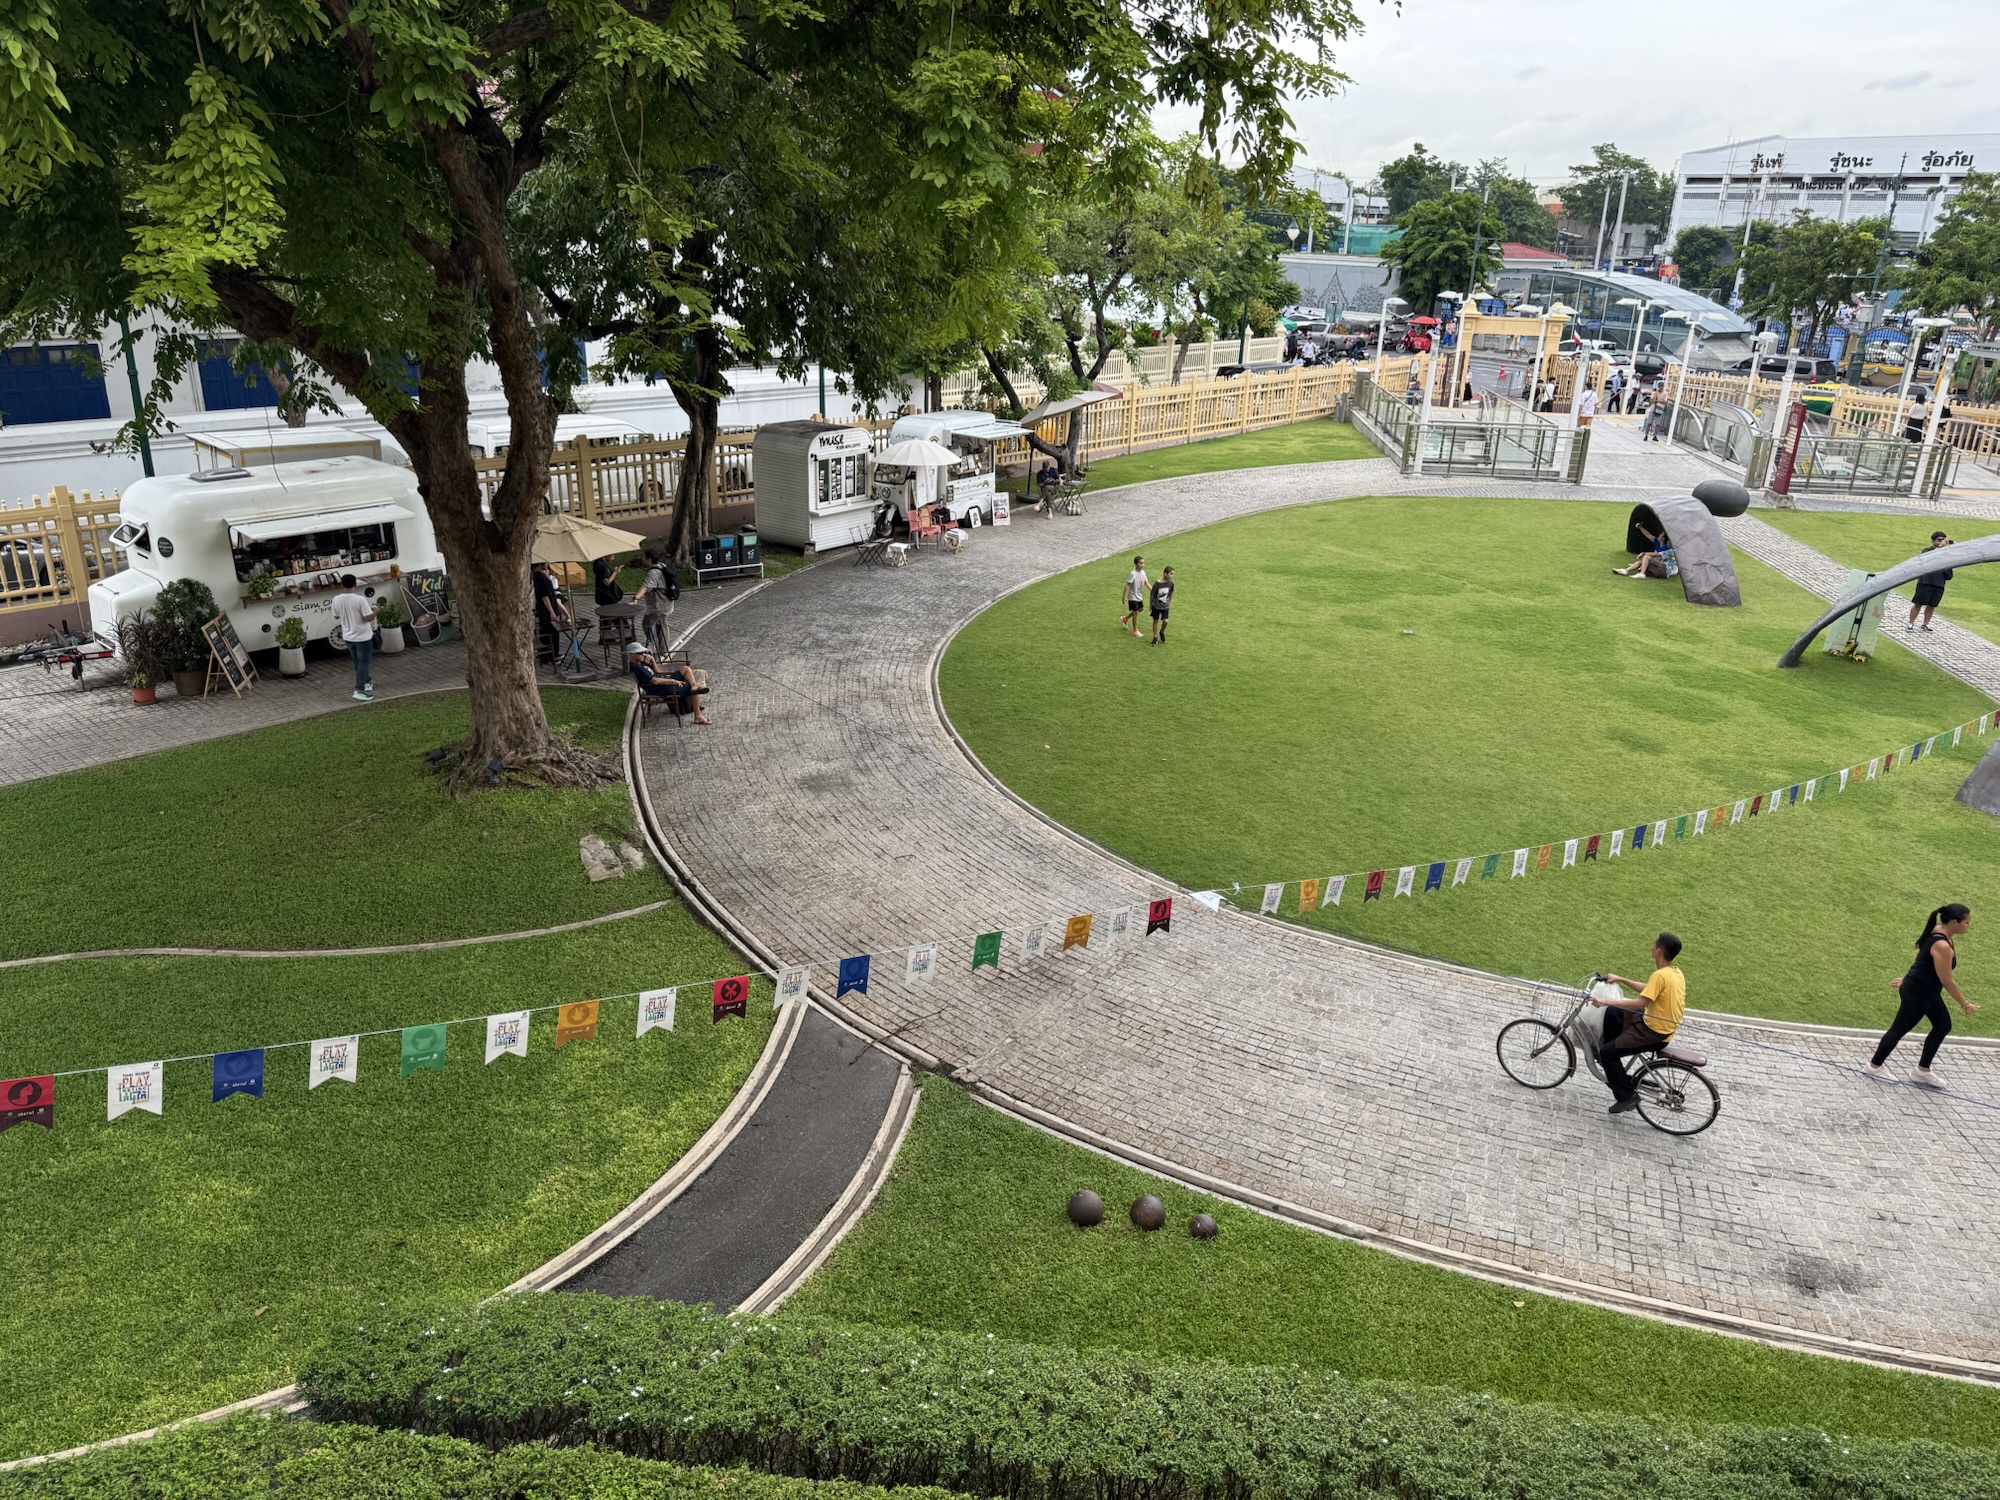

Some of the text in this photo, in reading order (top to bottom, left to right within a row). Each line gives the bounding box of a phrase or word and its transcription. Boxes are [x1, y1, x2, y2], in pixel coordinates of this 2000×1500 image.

[1829, 152, 1874, 172] รู้ชนะ
[1921, 150, 1974, 172] รู้อภัย
[412, 573, 422, 587] Hi
[292, 601, 320, 612] Siam
[498, 1023, 519, 1035] PLAY
[323, 1047, 347, 1060] PLAY
[122, 1075, 150, 1089] PLAY
